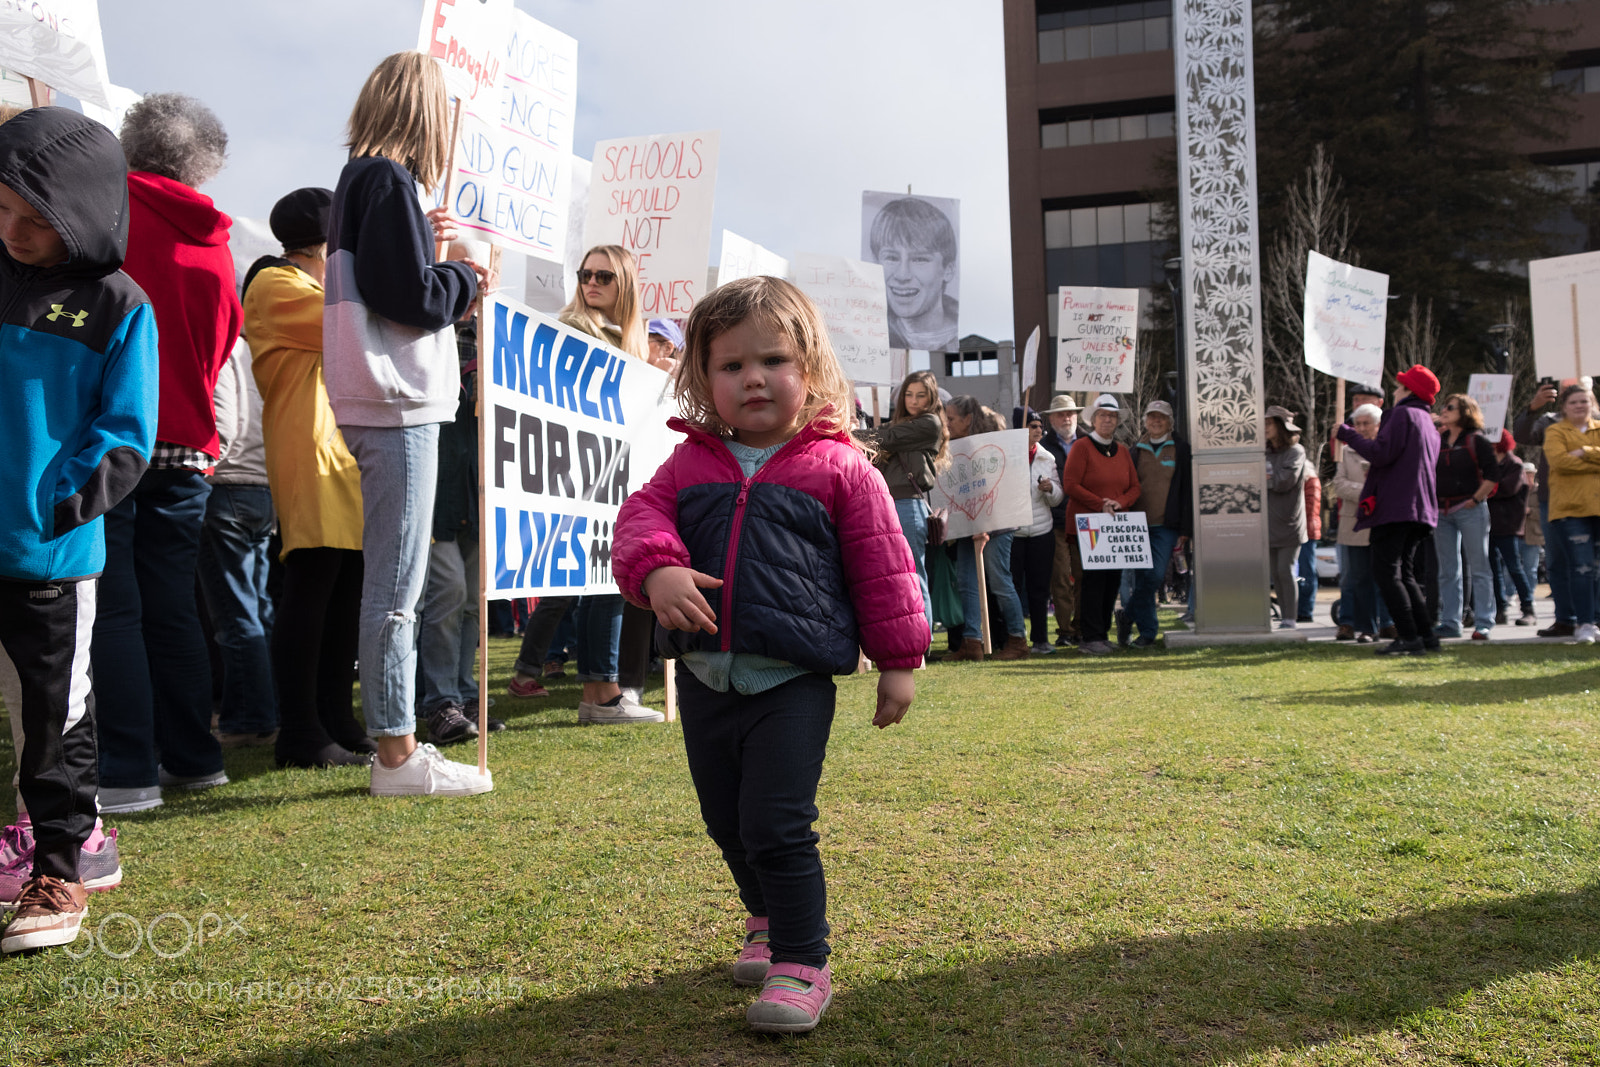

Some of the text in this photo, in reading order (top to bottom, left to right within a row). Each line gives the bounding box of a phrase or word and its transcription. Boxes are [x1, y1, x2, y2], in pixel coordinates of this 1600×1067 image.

[602, 139, 703, 182] SCHOOLS
[502, 146, 558, 198] GUN
[608, 185, 680, 215] SHOULD
[621, 217, 671, 249] NOT
[1073, 313, 1083, 321] IS
[1087, 313, 1105, 321] NOT
[1078, 324, 1131, 336] GUNPOINT
[1082, 342, 1119, 352] UNLESS
[493, 302, 626, 425] MARCH
[1067, 353, 1114, 365] YOU PROFIT
[494, 403, 575, 499] FOR
[972, 478, 987, 490] FOR
[1113, 514, 1128, 522] THE
[1100, 525, 1148, 534] EPISCOPAL
[1107, 535, 1145, 543] CHURCH
[494, 506, 587, 590] LIVES
[1111, 544, 1143, 553] CARES
[1088, 555, 1117, 563] ABOUT
[29, 590, 58, 599] PUMA
